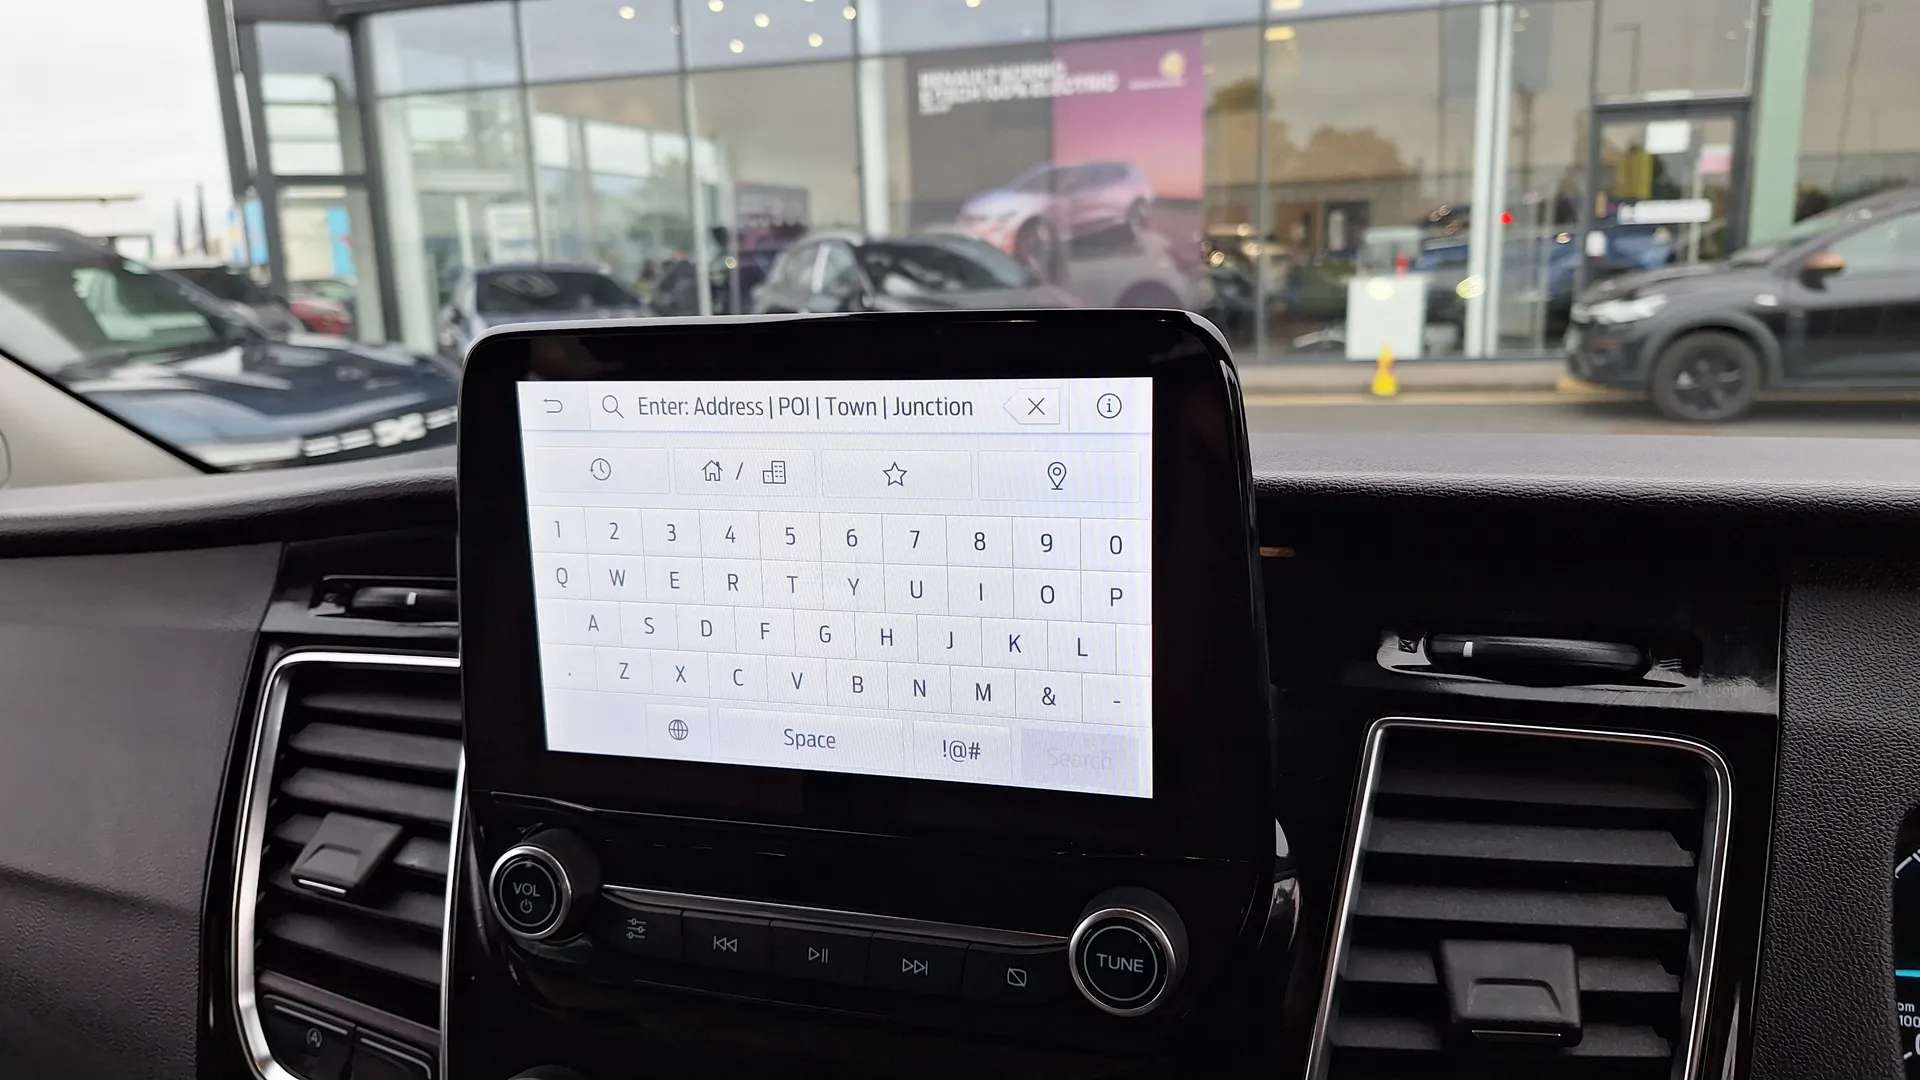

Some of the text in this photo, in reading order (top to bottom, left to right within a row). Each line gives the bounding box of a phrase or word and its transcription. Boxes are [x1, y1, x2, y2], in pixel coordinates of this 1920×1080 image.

[638, 396, 689, 416] Enter:
[693, 396, 764, 416] Address
[778, 396, 810, 416] POI
[824, 396, 877, 416] Town
[892, 396, 973, 417] Junction
[609, 521, 620, 540] 2
[666, 523, 677, 542] 3
[724, 525, 737, 544] 4
[785, 526, 796, 546] 5
[846, 528, 858, 548] 6
[909, 529, 920, 549] 7
[974, 531, 986, 551] 8
[1040, 533, 1053, 553] 9
[1109, 535, 1123, 555] 0
[556, 567, 569, 589] Q
[608, 569, 626, 587] W
[669, 571, 681, 590] E
[727, 573, 739, 592] R
[786, 575, 799, 594] T
[847, 577, 860, 596] Y
[910, 579, 923, 599] U
[1040, 584, 1055, 605] O
[1110, 587, 1123, 607] P
[588, 614, 1089, 657] A S D F G H J K L
[619, 662, 630, 680] Z
[675, 665, 687, 683] X
[733, 668, 744, 687] C
[790, 671, 803, 690] V
[852, 675, 864, 694] B
[913, 679, 926, 698] N
[975, 682, 992, 702] M
[1041, 686, 1057, 706] &
[783, 728, 1112, 770] Space !@# Search
[513, 882, 541, 897] VOL
[1097, 953, 1144, 973] TUNE
